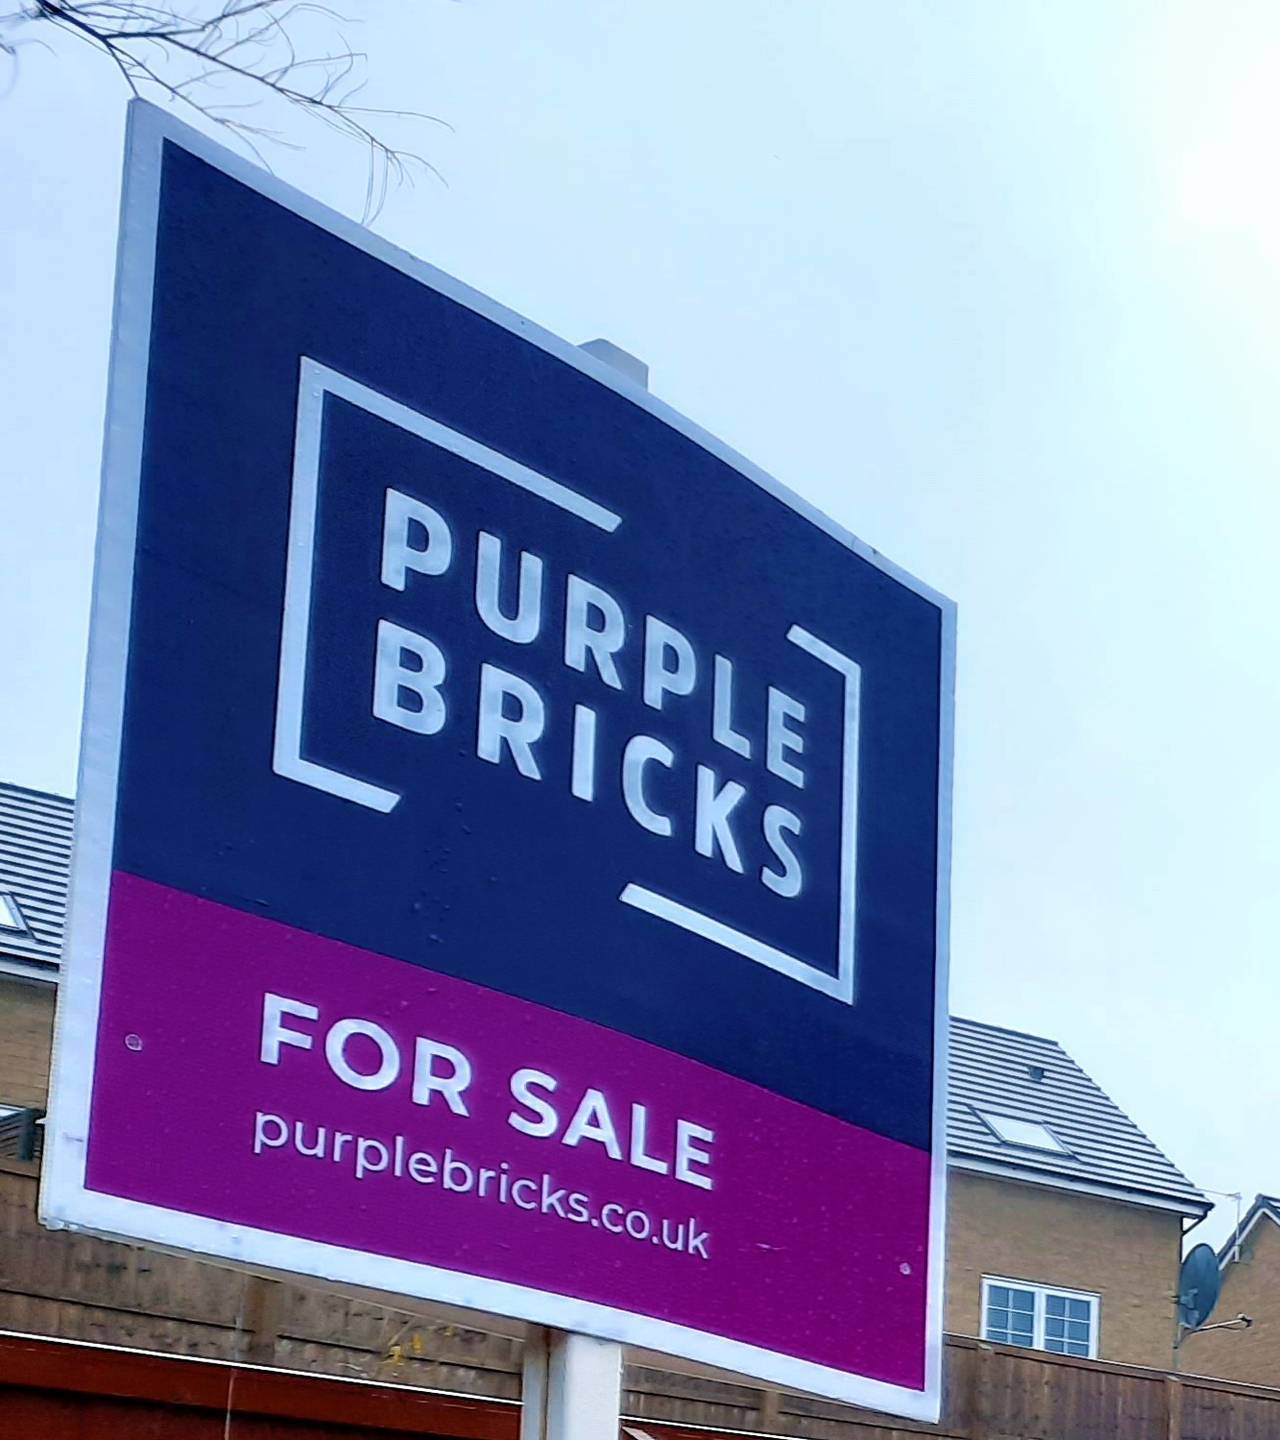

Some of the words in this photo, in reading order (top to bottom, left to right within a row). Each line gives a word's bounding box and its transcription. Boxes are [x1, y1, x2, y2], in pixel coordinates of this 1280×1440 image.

[381, 488, 805, 788] PURPLE
[373, 619, 803, 898] BRICKS
[254, 1111, 710, 1259] purplebricks.co.uk
[260, 992, 473, 1116] FOR
[508, 1067, 714, 1190] SALE
